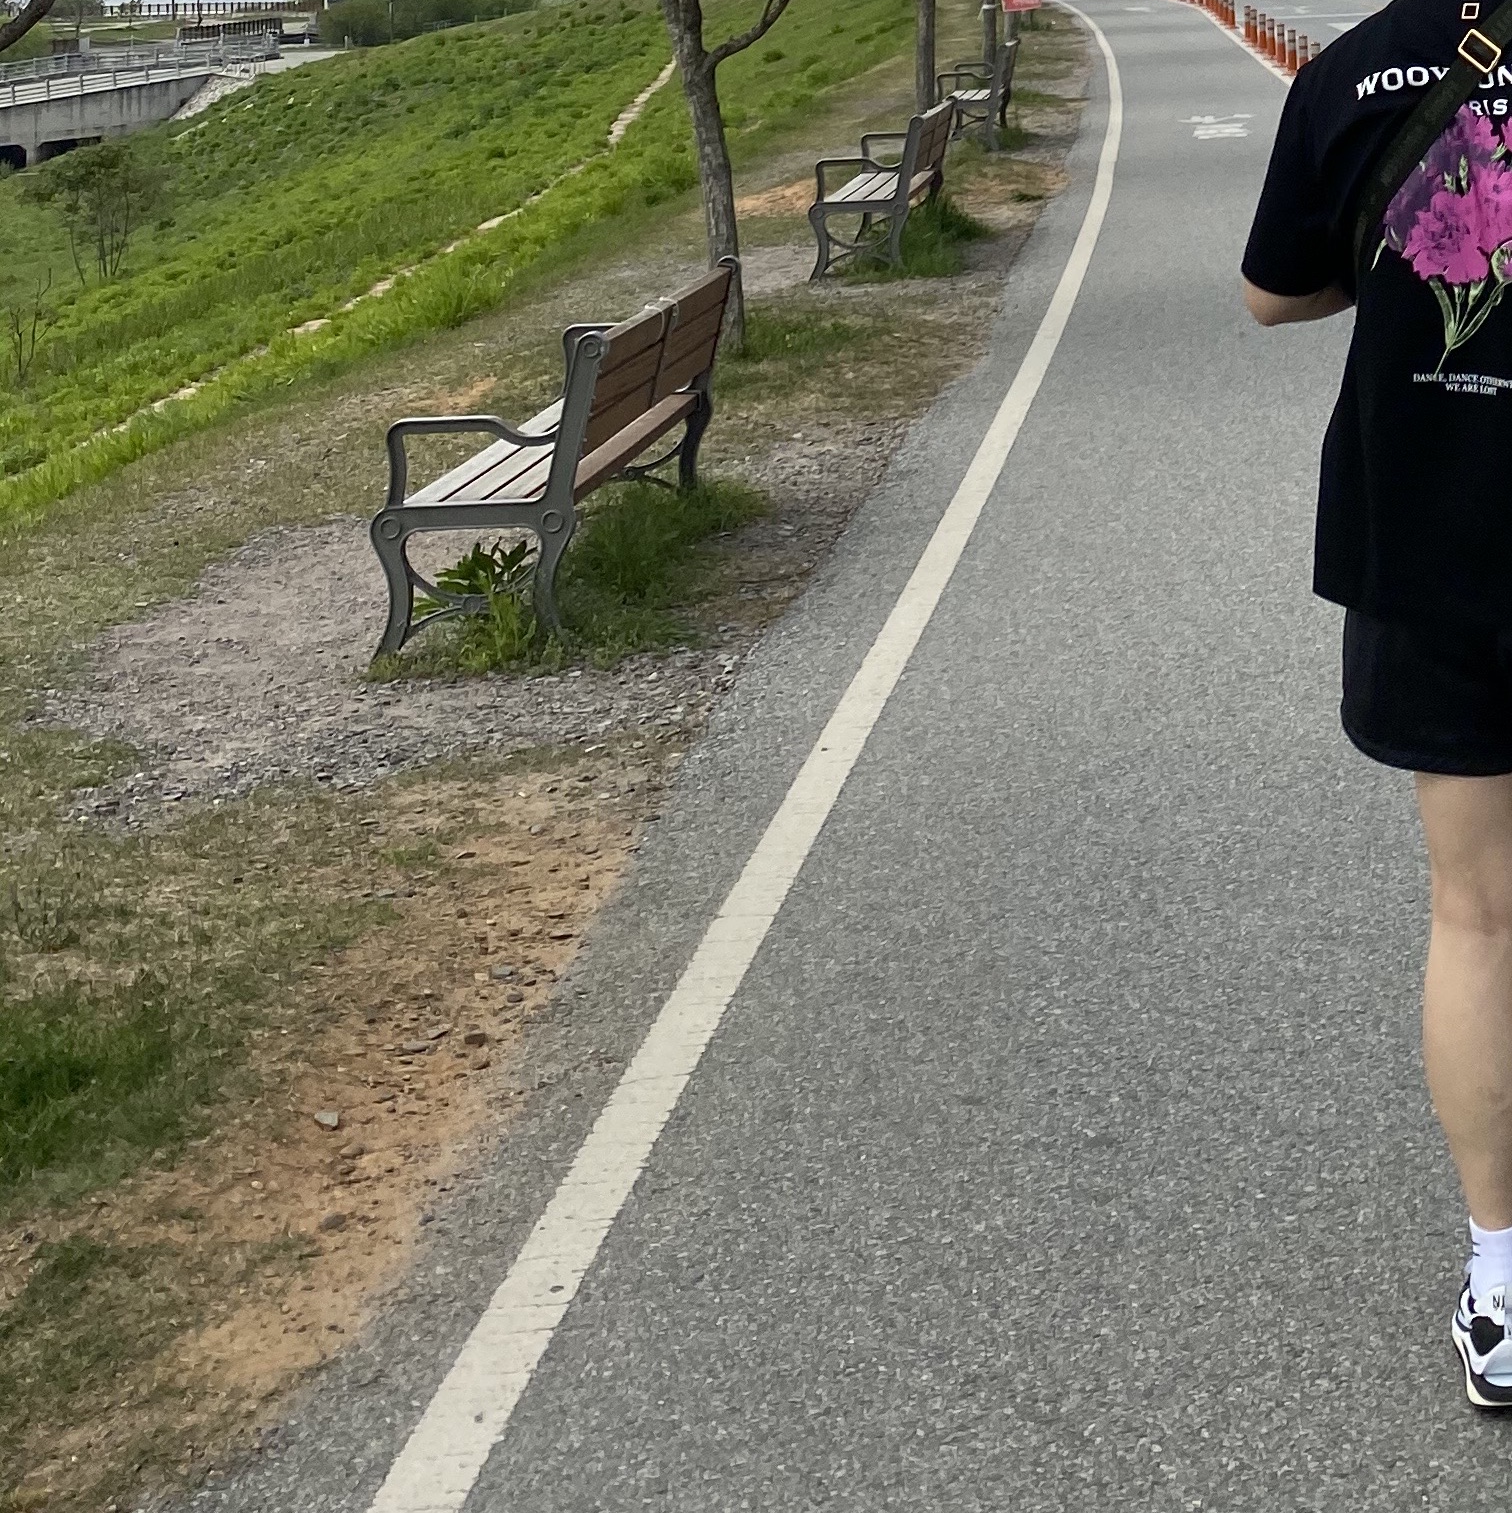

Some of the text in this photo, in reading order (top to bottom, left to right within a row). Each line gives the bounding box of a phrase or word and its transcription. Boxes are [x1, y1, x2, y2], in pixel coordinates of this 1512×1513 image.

[1445, 382, 1498, 396] WE ARE LOST
